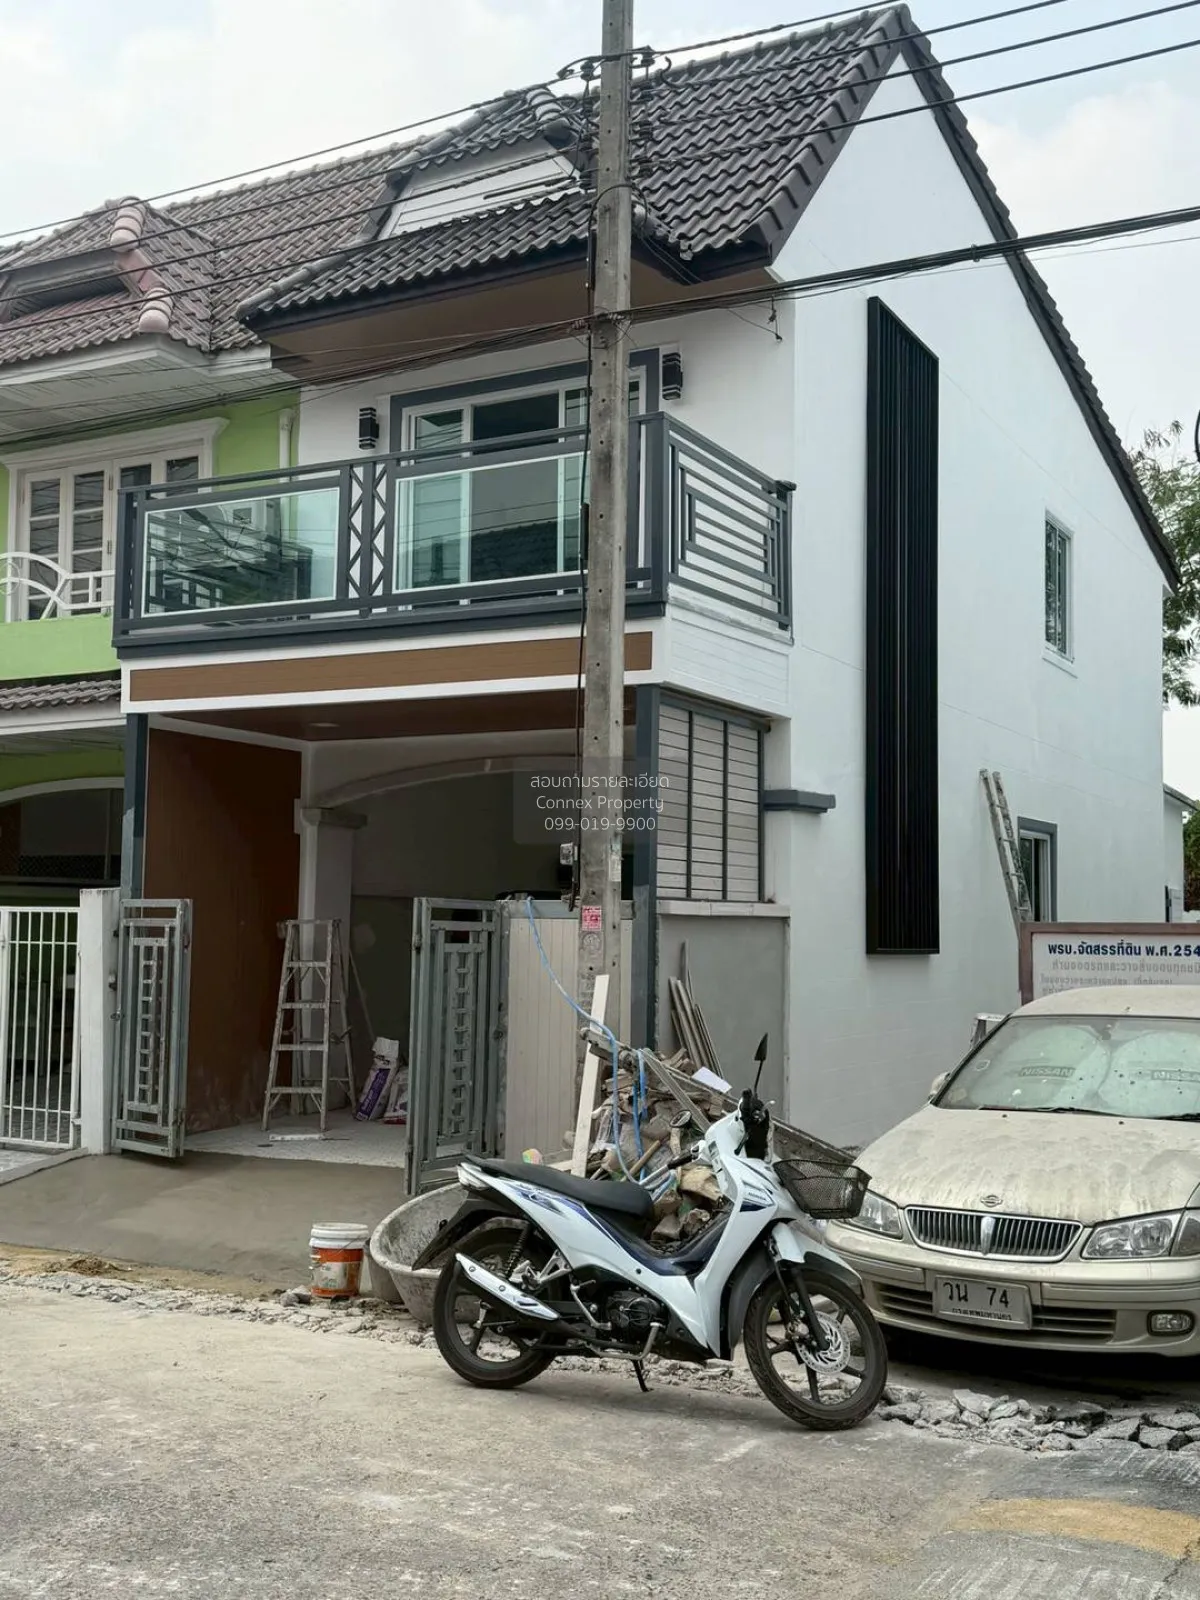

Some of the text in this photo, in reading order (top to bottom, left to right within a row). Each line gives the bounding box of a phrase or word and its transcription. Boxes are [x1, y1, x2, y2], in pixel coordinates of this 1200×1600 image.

[1048, 939, 1141, 957] พรบ.จัดสรรที่ดิน
[1020, 1067, 1074, 1077] NISSAN
[943, 1282, 1009, 1308] วน 74
